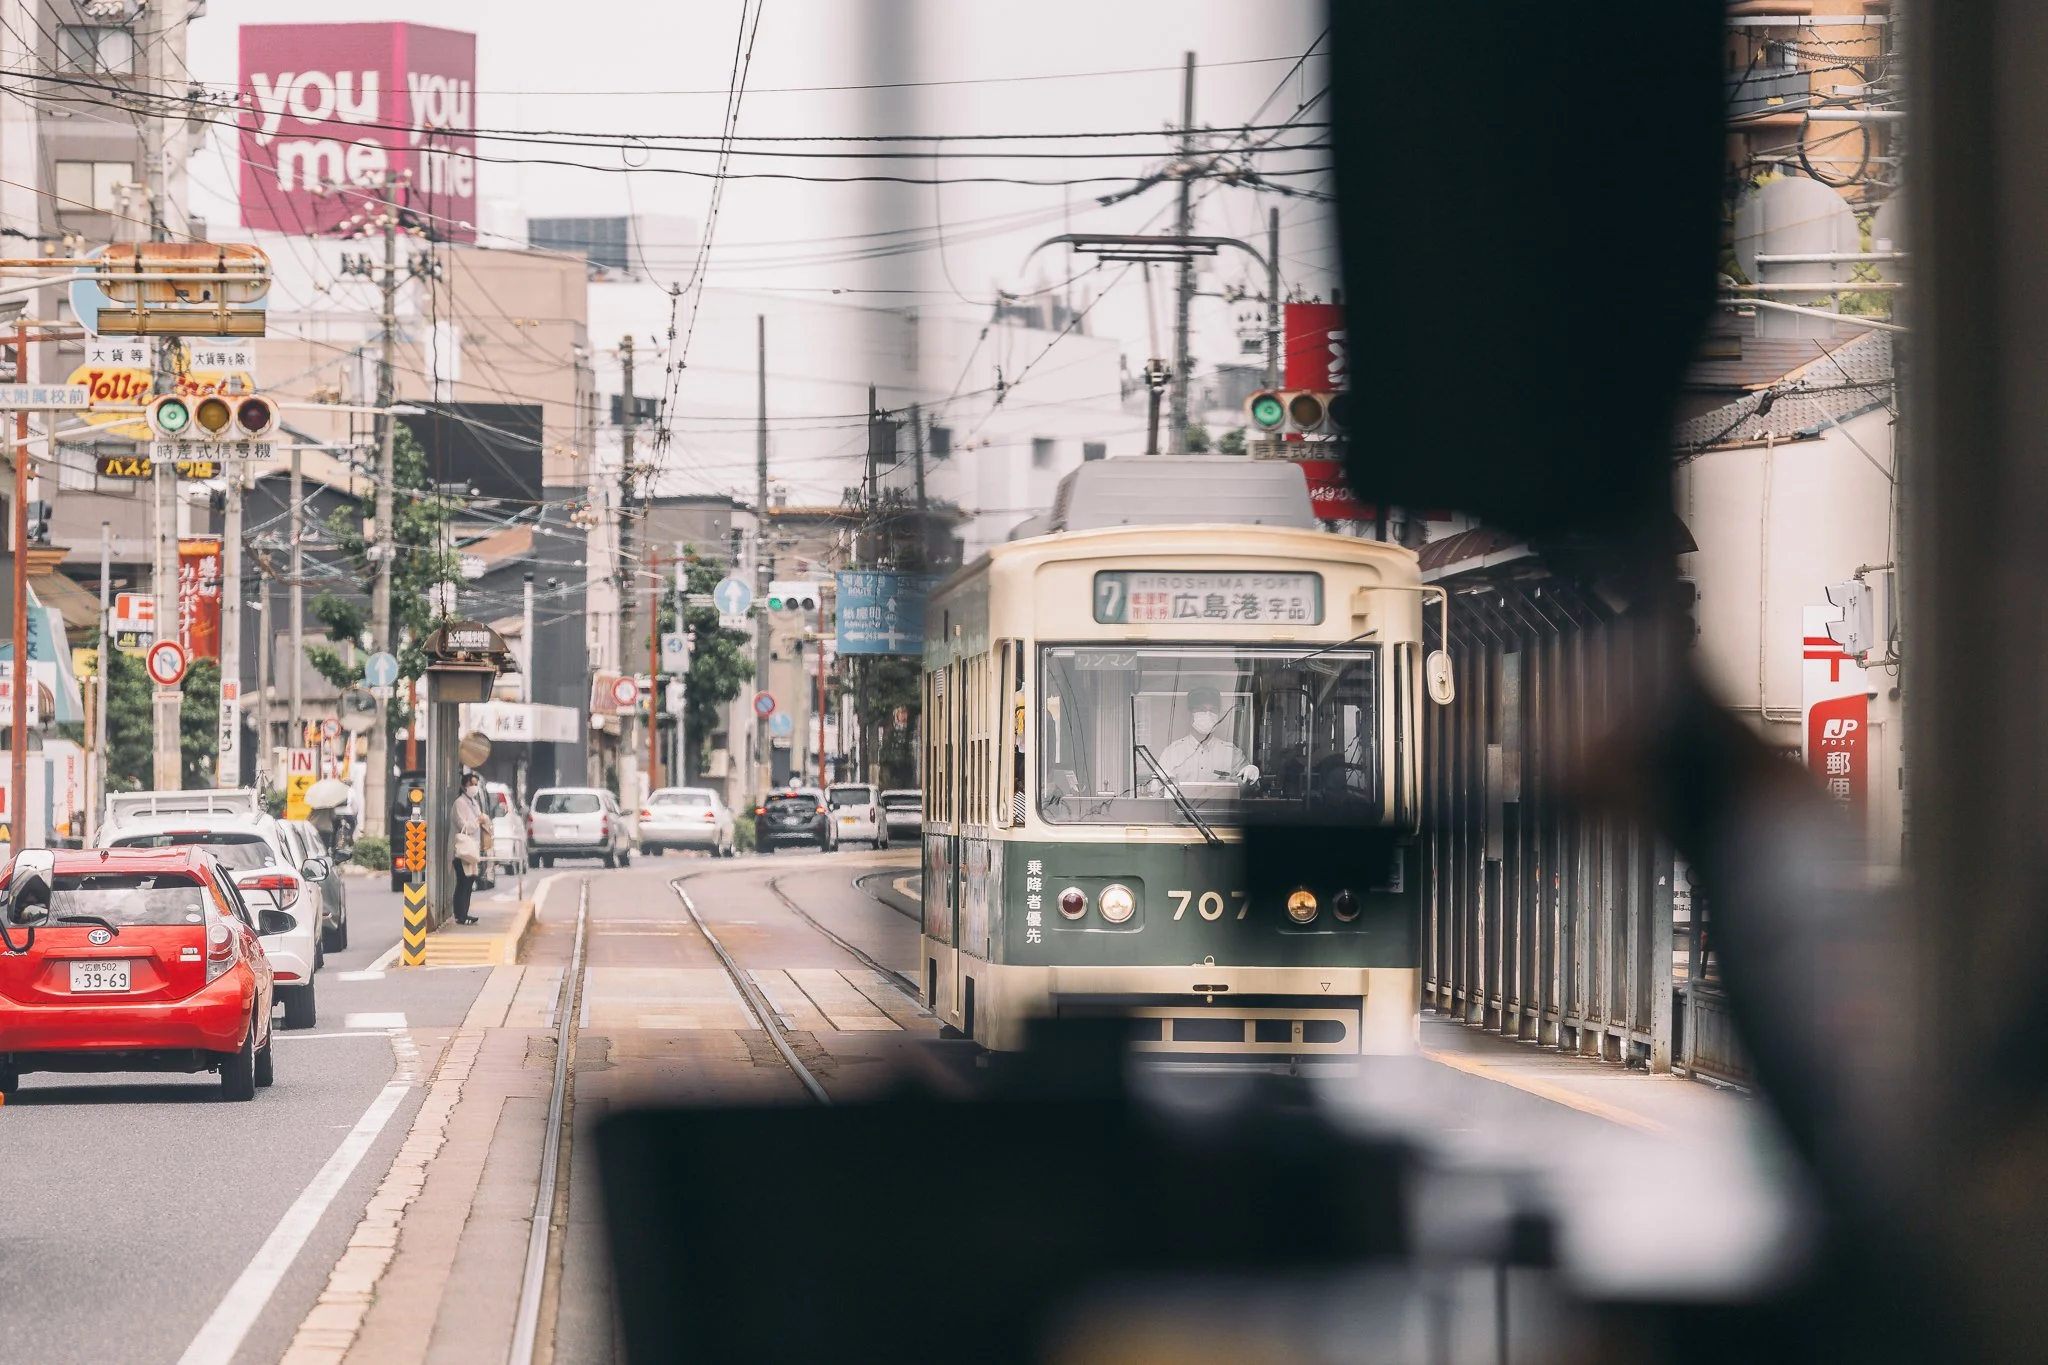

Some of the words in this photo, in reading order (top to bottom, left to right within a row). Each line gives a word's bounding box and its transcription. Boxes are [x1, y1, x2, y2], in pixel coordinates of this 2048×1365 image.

[251, 70, 378, 146] you
[407, 72, 470, 146] you
[277, 138, 388, 192] me
[420, 143, 473, 198] me
[92, 349, 144, 362] 大貨等
[194, 352, 253, 365] 大貨等を除く
[78, 372, 149, 407] Jolly
[157, 443, 271, 459] 時差式信号機
[1101, 581, 1122, 617] 7
[1137, 577, 1242, 590] HIROSHIMA
[1252, 577, 1302, 590] PORT
[1078, 652, 1136, 667] ワンマン
[292, 752, 312, 771] IN
[1826, 751, 1851, 808] 郵便
[1026, 860, 1042, 944] 乗降者優先
[1167, 890, 1251, 921] 707
[83, 973, 128, 988] 39-69
